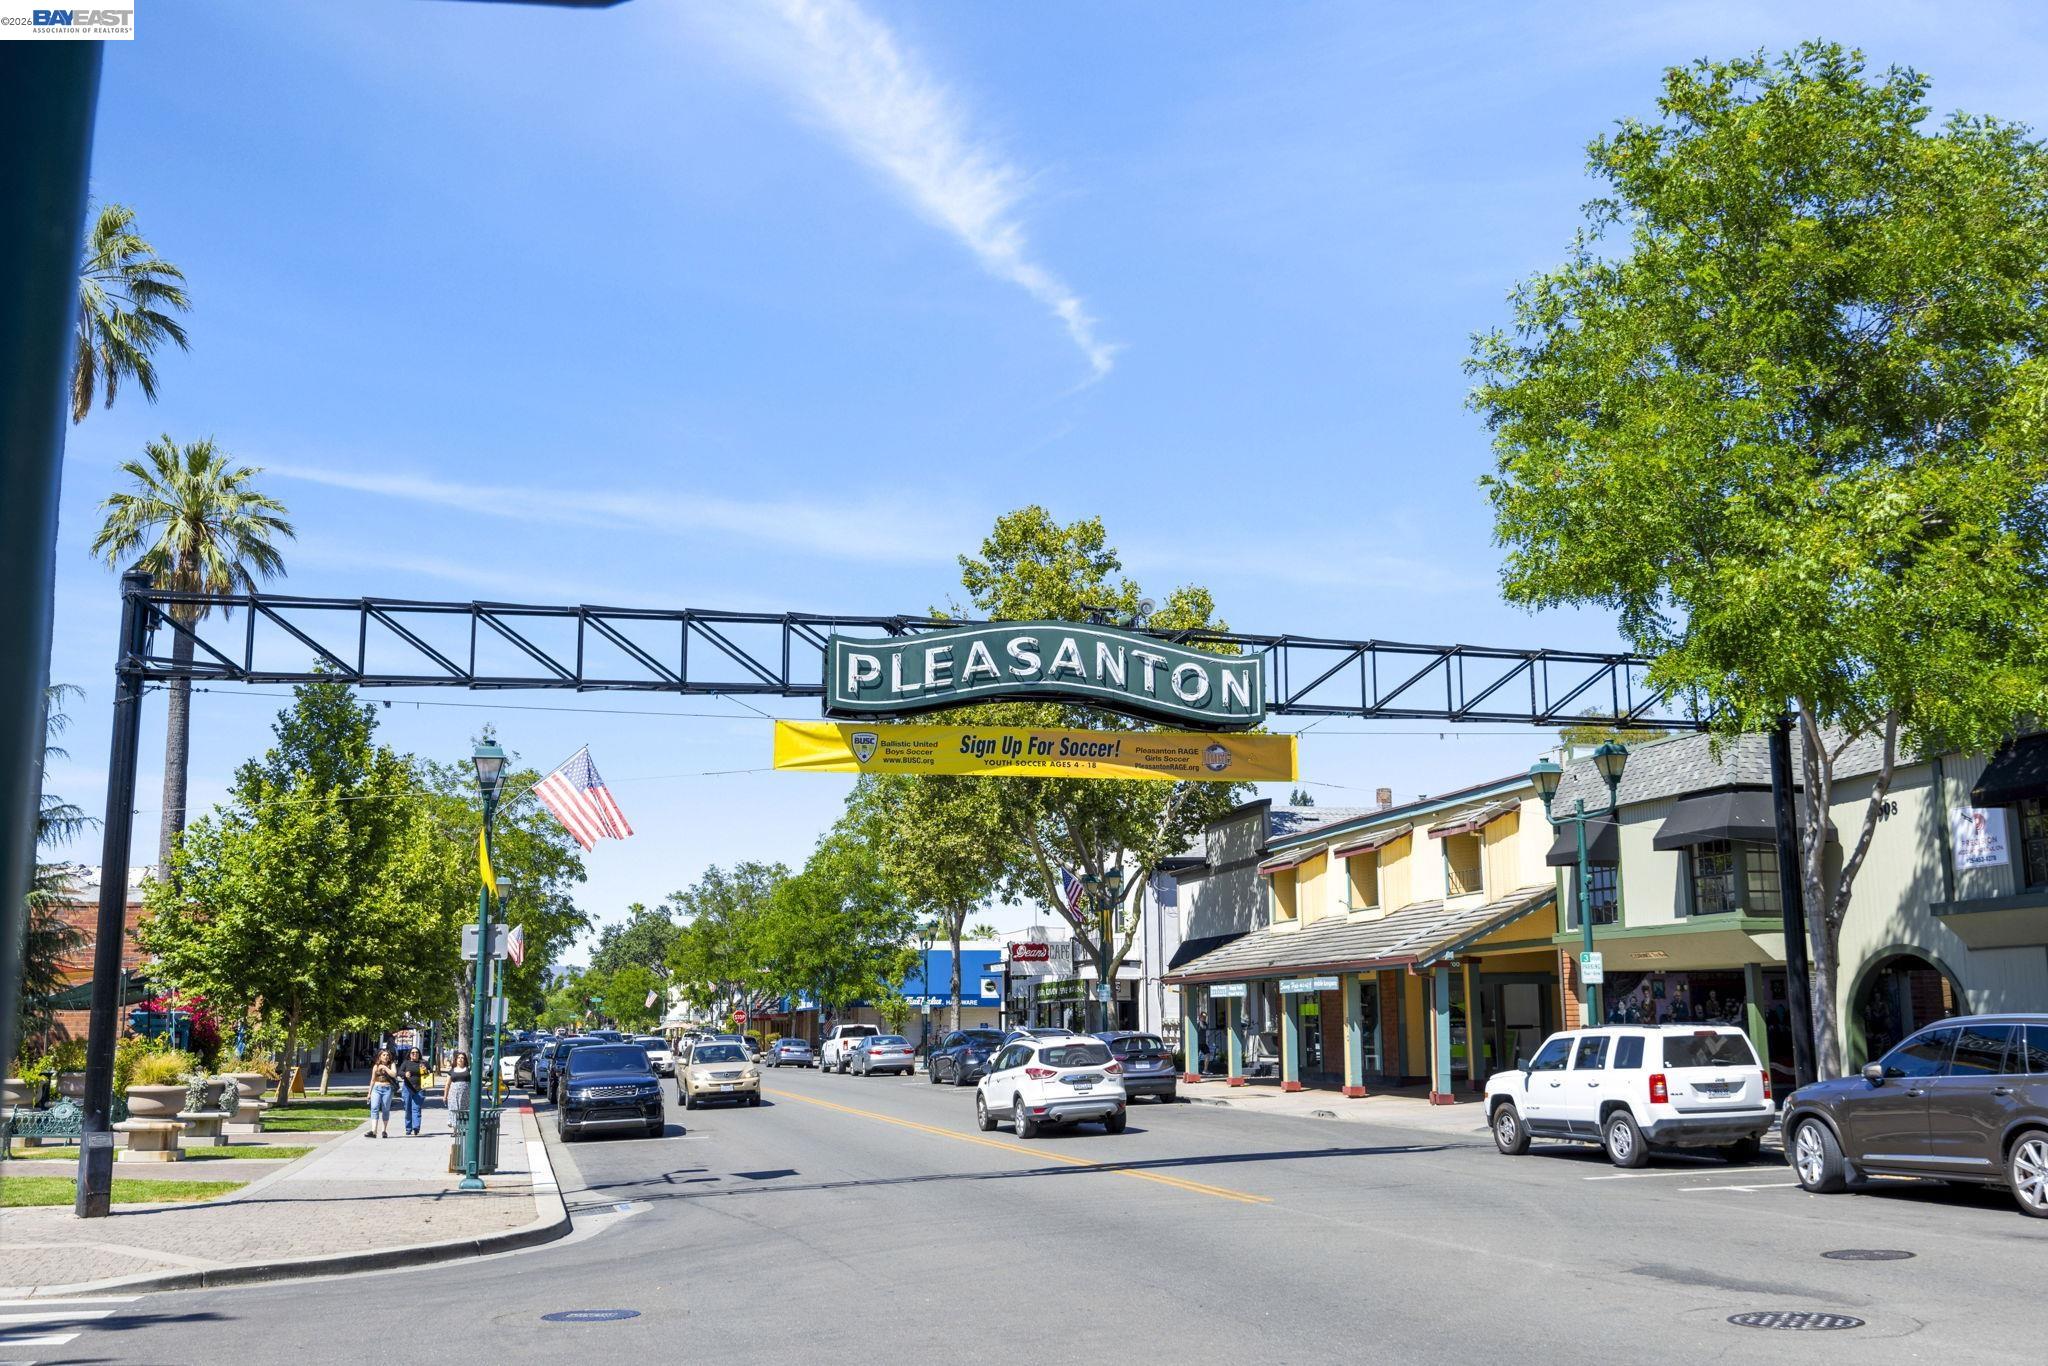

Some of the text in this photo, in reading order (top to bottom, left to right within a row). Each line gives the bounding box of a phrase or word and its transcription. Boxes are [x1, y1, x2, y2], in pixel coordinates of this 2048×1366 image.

[847, 636, 1250, 708] PLEASANTON
[854, 737, 875, 745] BUSC
[880, 740, 911, 748] Ballistic
[960, 735, 1121, 758] Sign Up For Soccer!
[885, 748, 933, 756] Boys Soccer
[1135, 747, 1176, 755] Pleasanton
[882, 757, 935, 766] www.BUSC.org
[1163, 755, 1190, 763] Soccer
[1134, 762, 1200, 771] PleasantonRAGE.org
[1583, 954, 1590, 962] 3
